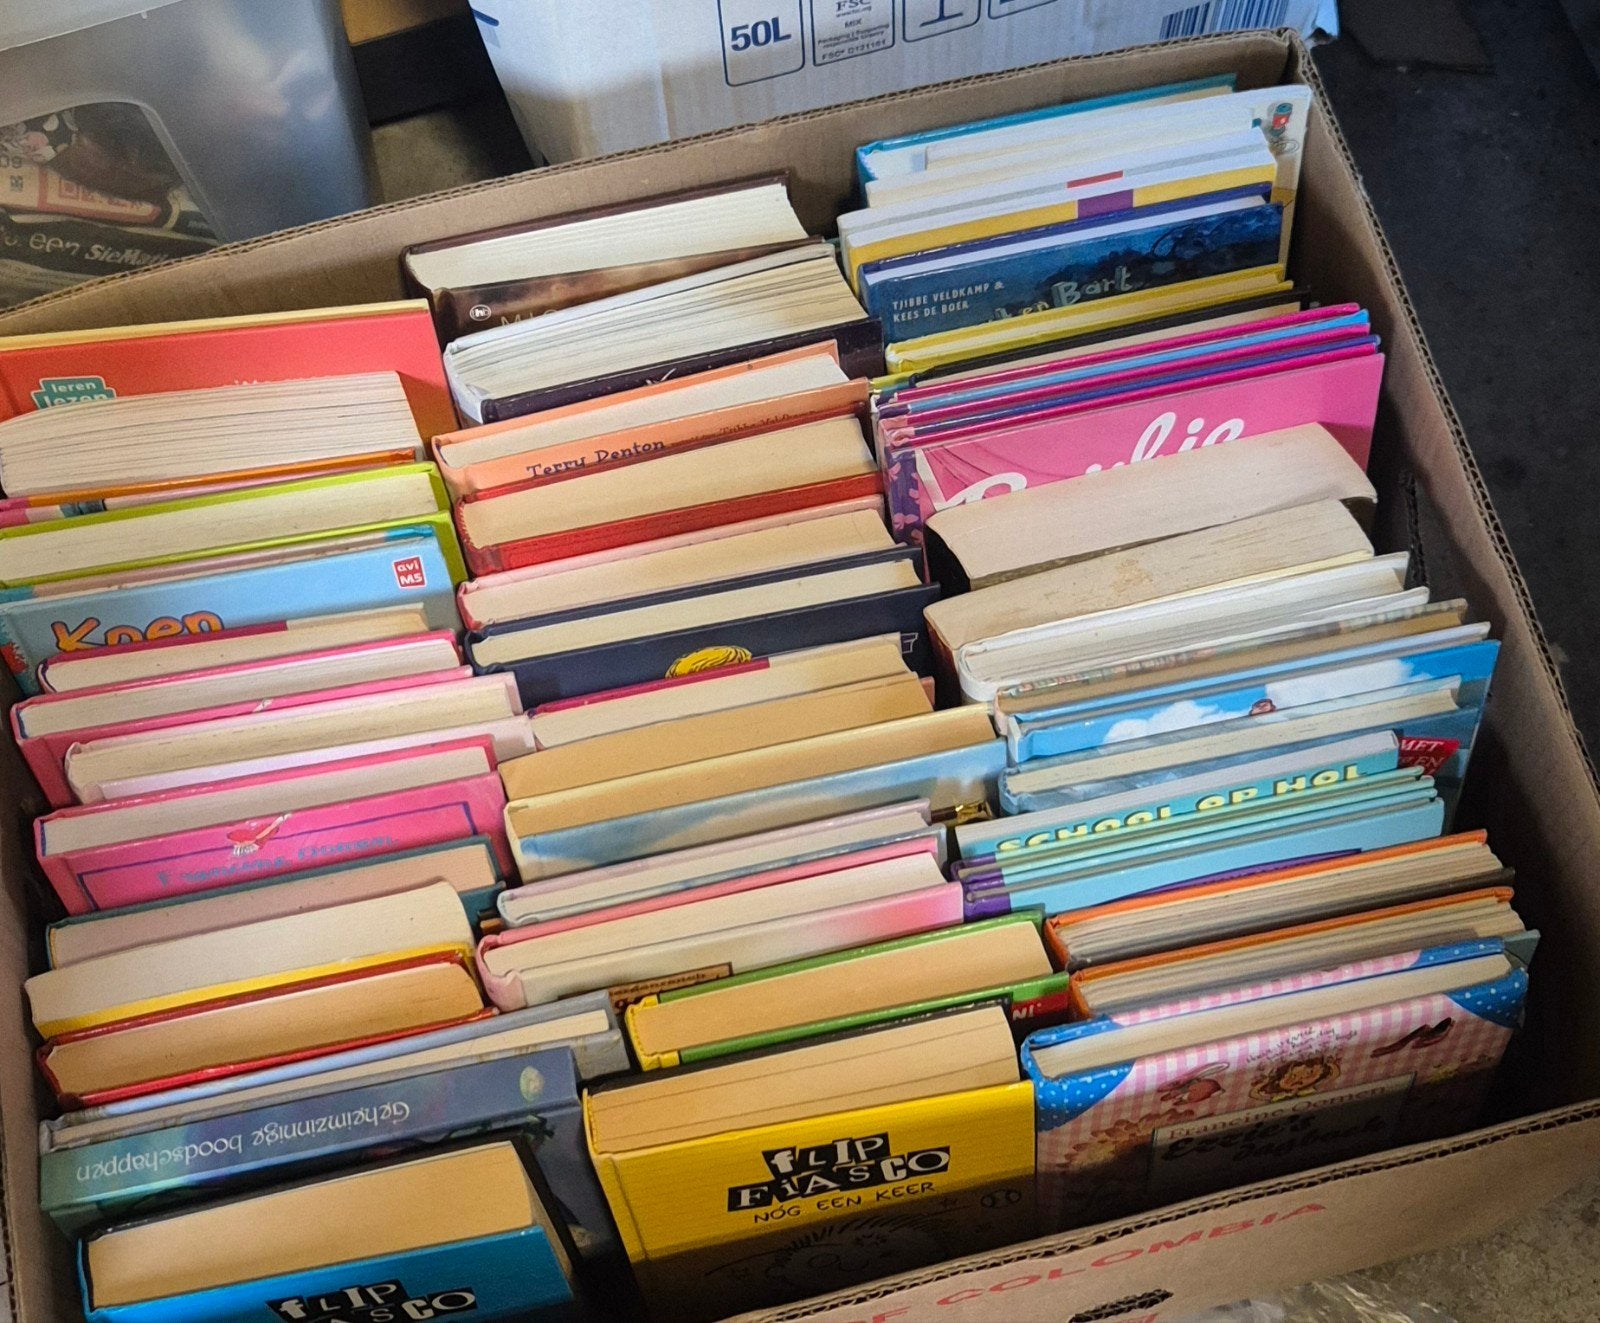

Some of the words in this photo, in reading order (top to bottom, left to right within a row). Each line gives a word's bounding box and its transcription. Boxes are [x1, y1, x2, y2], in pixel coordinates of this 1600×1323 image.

[731, 16, 792, 51] 50L
[844, 18, 863, 29] MIX
[892, 295, 929, 311] TJIBBE
[932, 283, 990, 302] VELDKAMP
[1052, 265, 1133, 308] Bart
[893, 312, 919, 323] KEES
[923, 307, 938, 317] DE
[941, 301, 970, 315] BOER
[51, 382, 97, 393] leren
[526, 456, 587, 478] Terry
[594, 440, 666, 464] Denton
[251, 1100, 411, 1147] Geheimzinnige
[76, 1135, 243, 1182] boodschappen
[816, 1195, 862, 1210] EEN
[876, 1181, 935, 1201] KEER
[936, 1203, 1328, 1306] COLOMBIA
